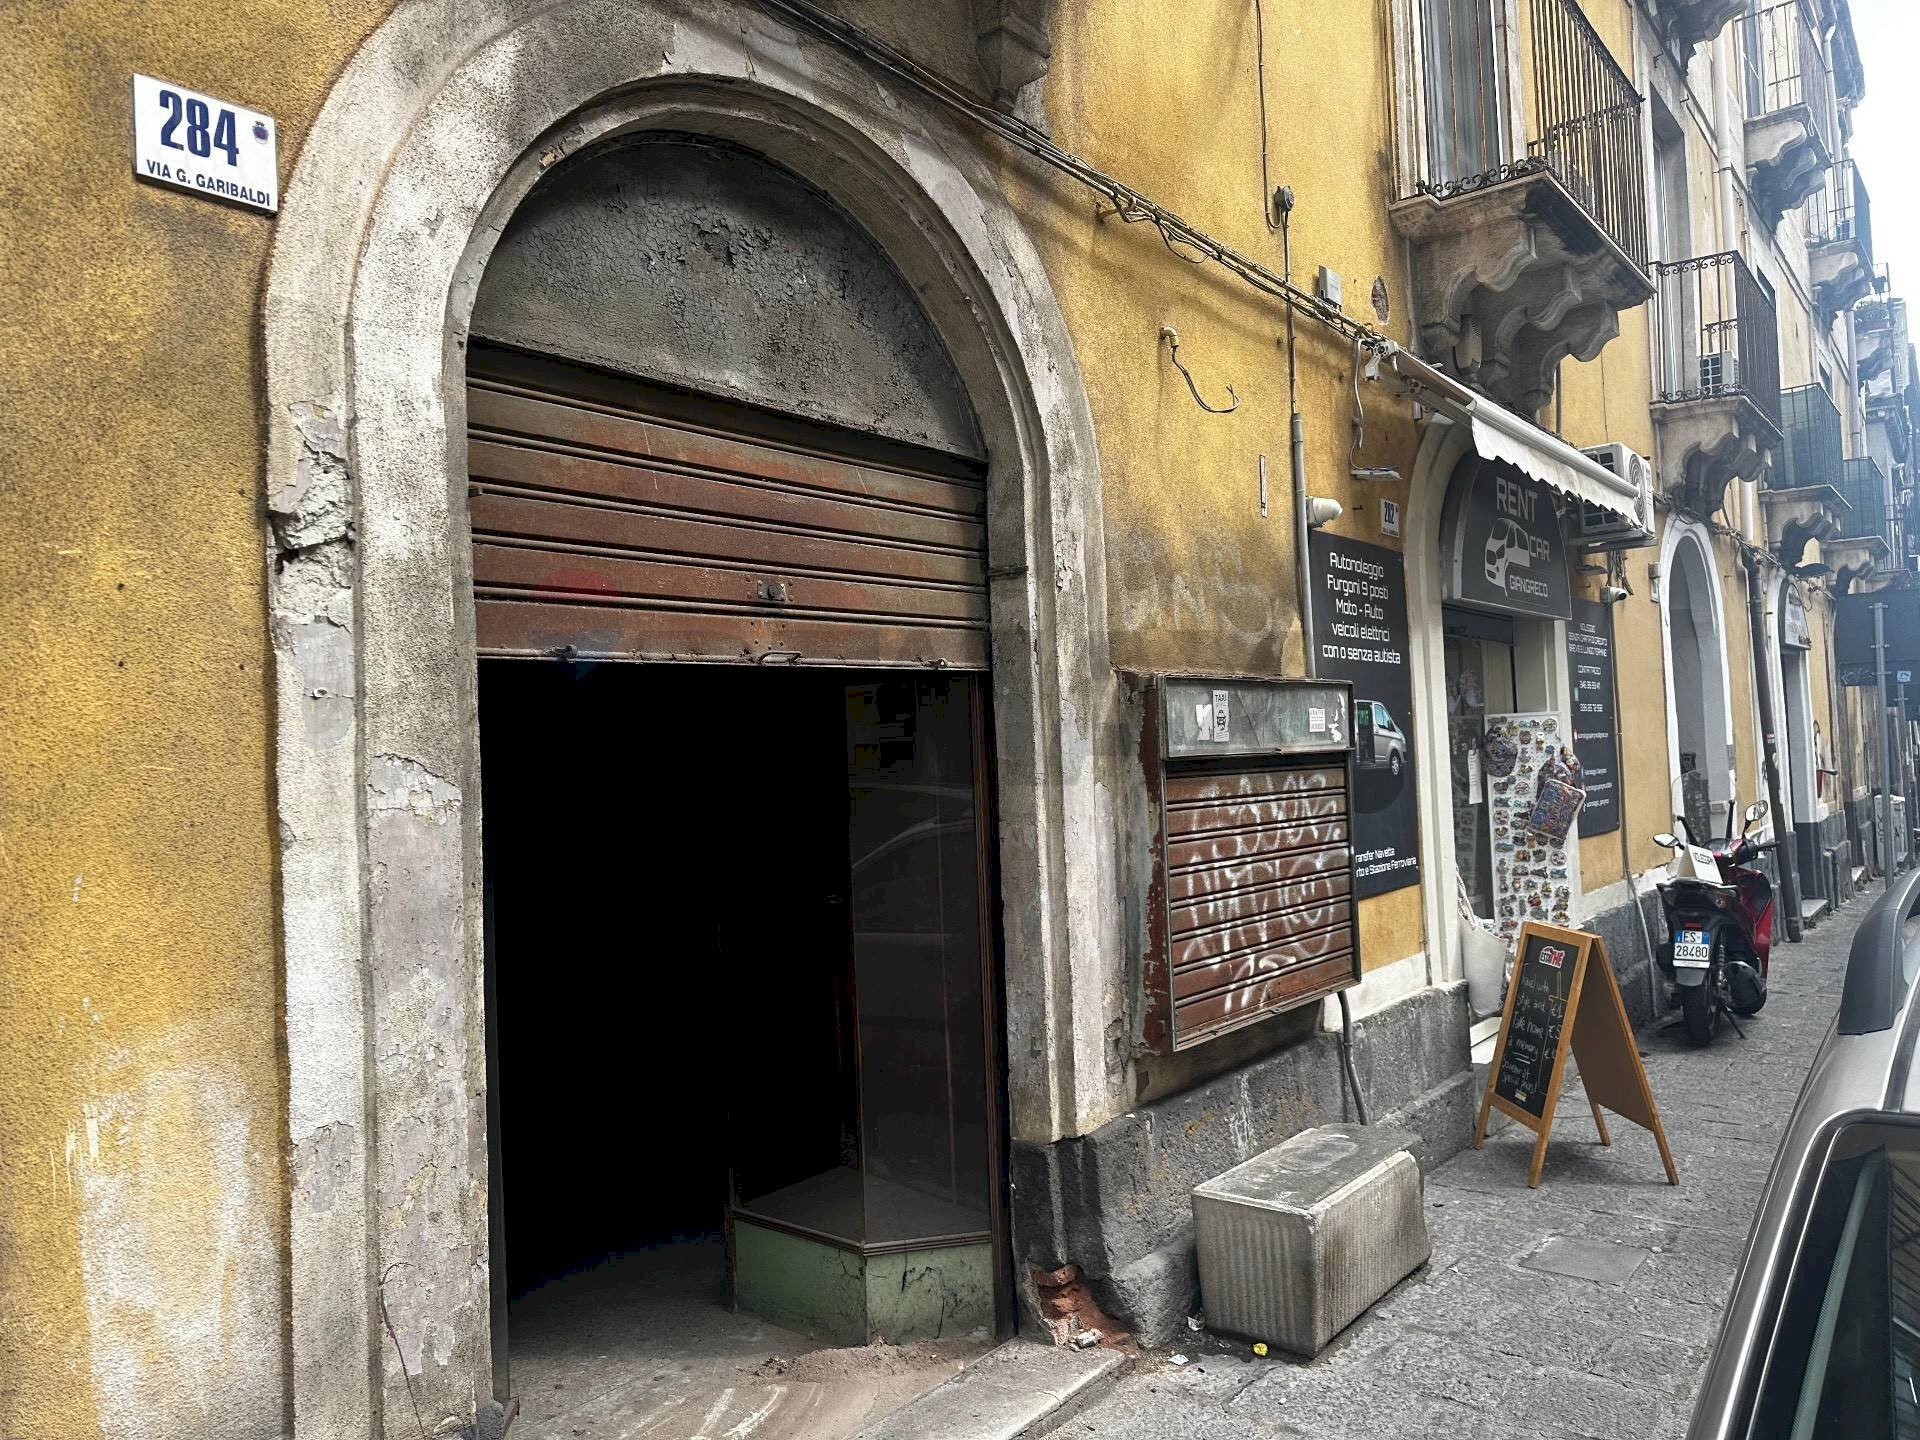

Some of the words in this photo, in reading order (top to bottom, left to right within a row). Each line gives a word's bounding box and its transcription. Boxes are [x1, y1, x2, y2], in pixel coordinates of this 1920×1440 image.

[159, 90, 239, 167] 284
[146, 159, 171, 179] VIA
[176, 168, 191, 184] G.
[196, 173, 270, 206] GARIBALDI
[1496, 477, 1538, 523] RENT
[1529, 535, 1550, 562] CAR
[1329, 552, 1384, 580] Autonoleggio
[1327, 574, 1360, 596] Furgoni
[1361, 581, 1368, 596] 9
[1370, 585, 1389, 600] posti
[1509, 575, 1549, 597] GIANGRECO
[1335, 598, 1357, 615] Moto
[1364, 604, 1384, 620] Auto
[1331, 621, 1359, 638] veicoli
[1361, 624, 1390, 642] elettrici
[1322, 644, 1339, 658] con
[1340, 647, 1346, 659] o
[1347, 647, 1373, 661] senza
[1374, 648, 1401, 664] autista
[1355, 850, 1374, 863] ransfer
[1375, 847, 1395, 859] Navetta
[1369, 862, 1391, 875] Stazione
[1391, 856, 1417, 869] Ferroviaria
[1683, 931, 1696, 943] ES
[1675, 945, 1708, 958] 28480
